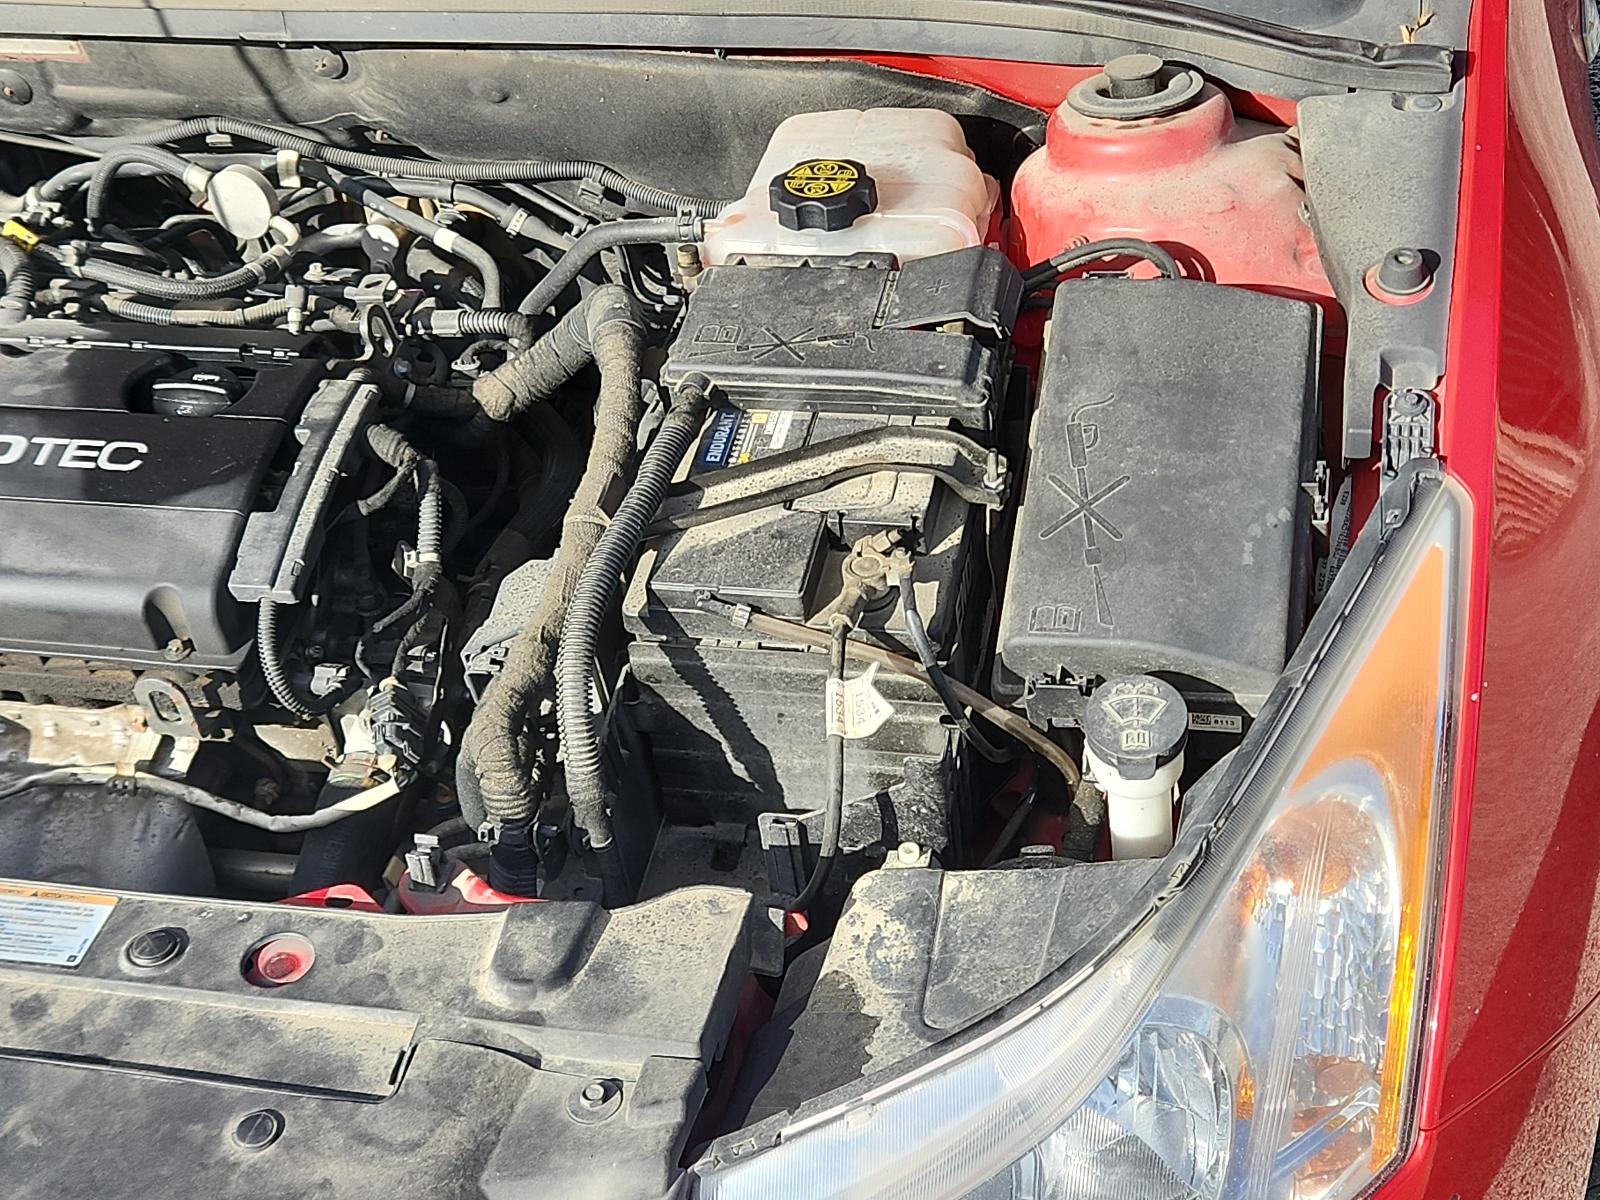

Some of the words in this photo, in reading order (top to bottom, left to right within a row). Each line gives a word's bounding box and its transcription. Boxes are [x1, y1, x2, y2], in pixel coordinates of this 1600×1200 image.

[706, 412, 736, 462] ENDURANT
[835, 692, 845, 724] 1534
[855, 691, 867, 725] 1534
